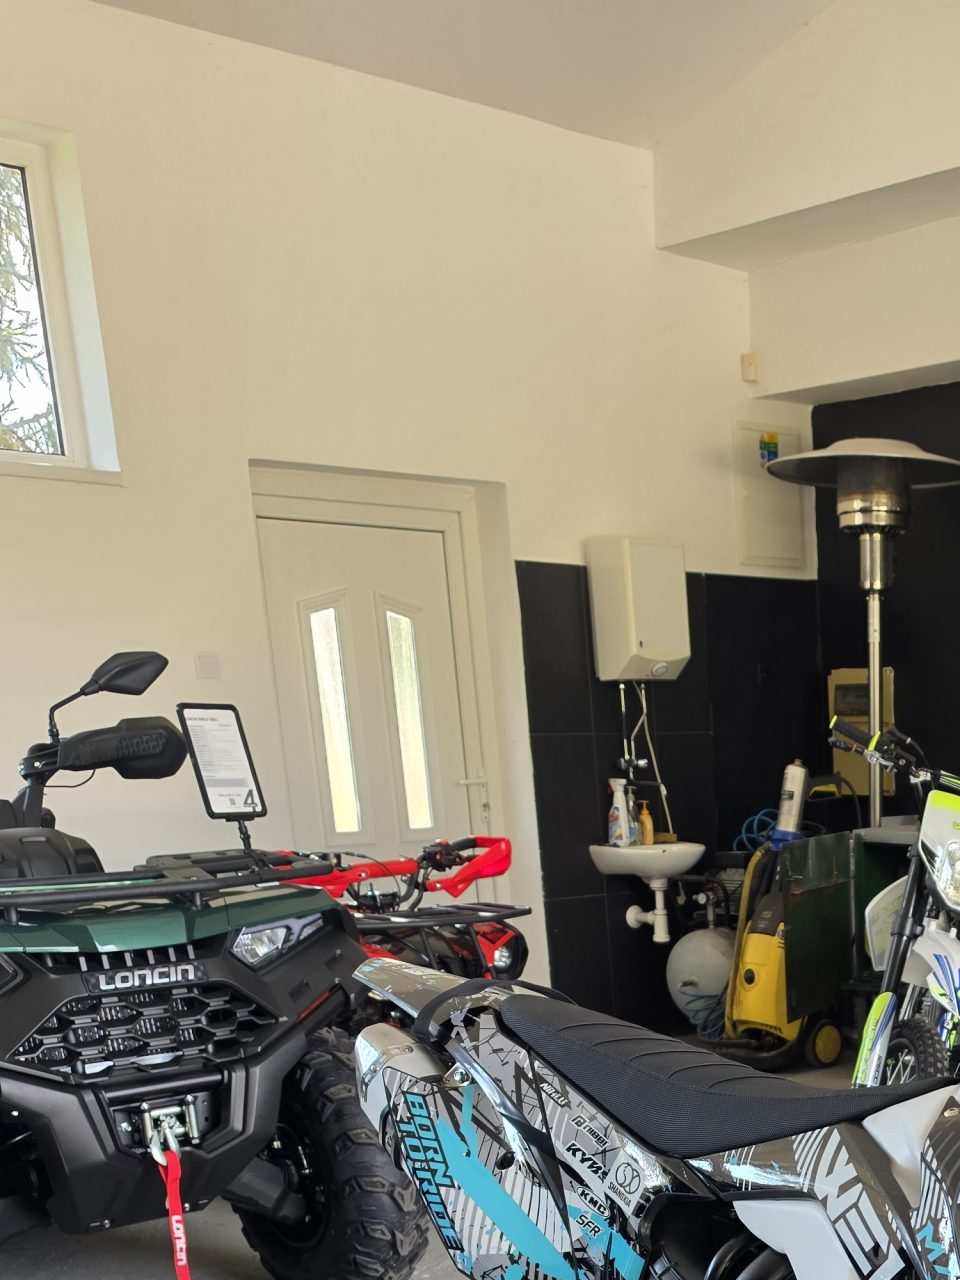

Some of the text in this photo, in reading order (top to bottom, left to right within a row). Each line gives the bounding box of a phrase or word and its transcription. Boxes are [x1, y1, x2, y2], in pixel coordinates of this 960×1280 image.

[98, 963, 195, 991] LONCIN
[404, 1091, 454, 1188] BORN
[399, 1118, 463, 1251] TO RIDE
[580, 1189, 607, 1216] KMC
[575, 1214, 602, 1237] SFR
